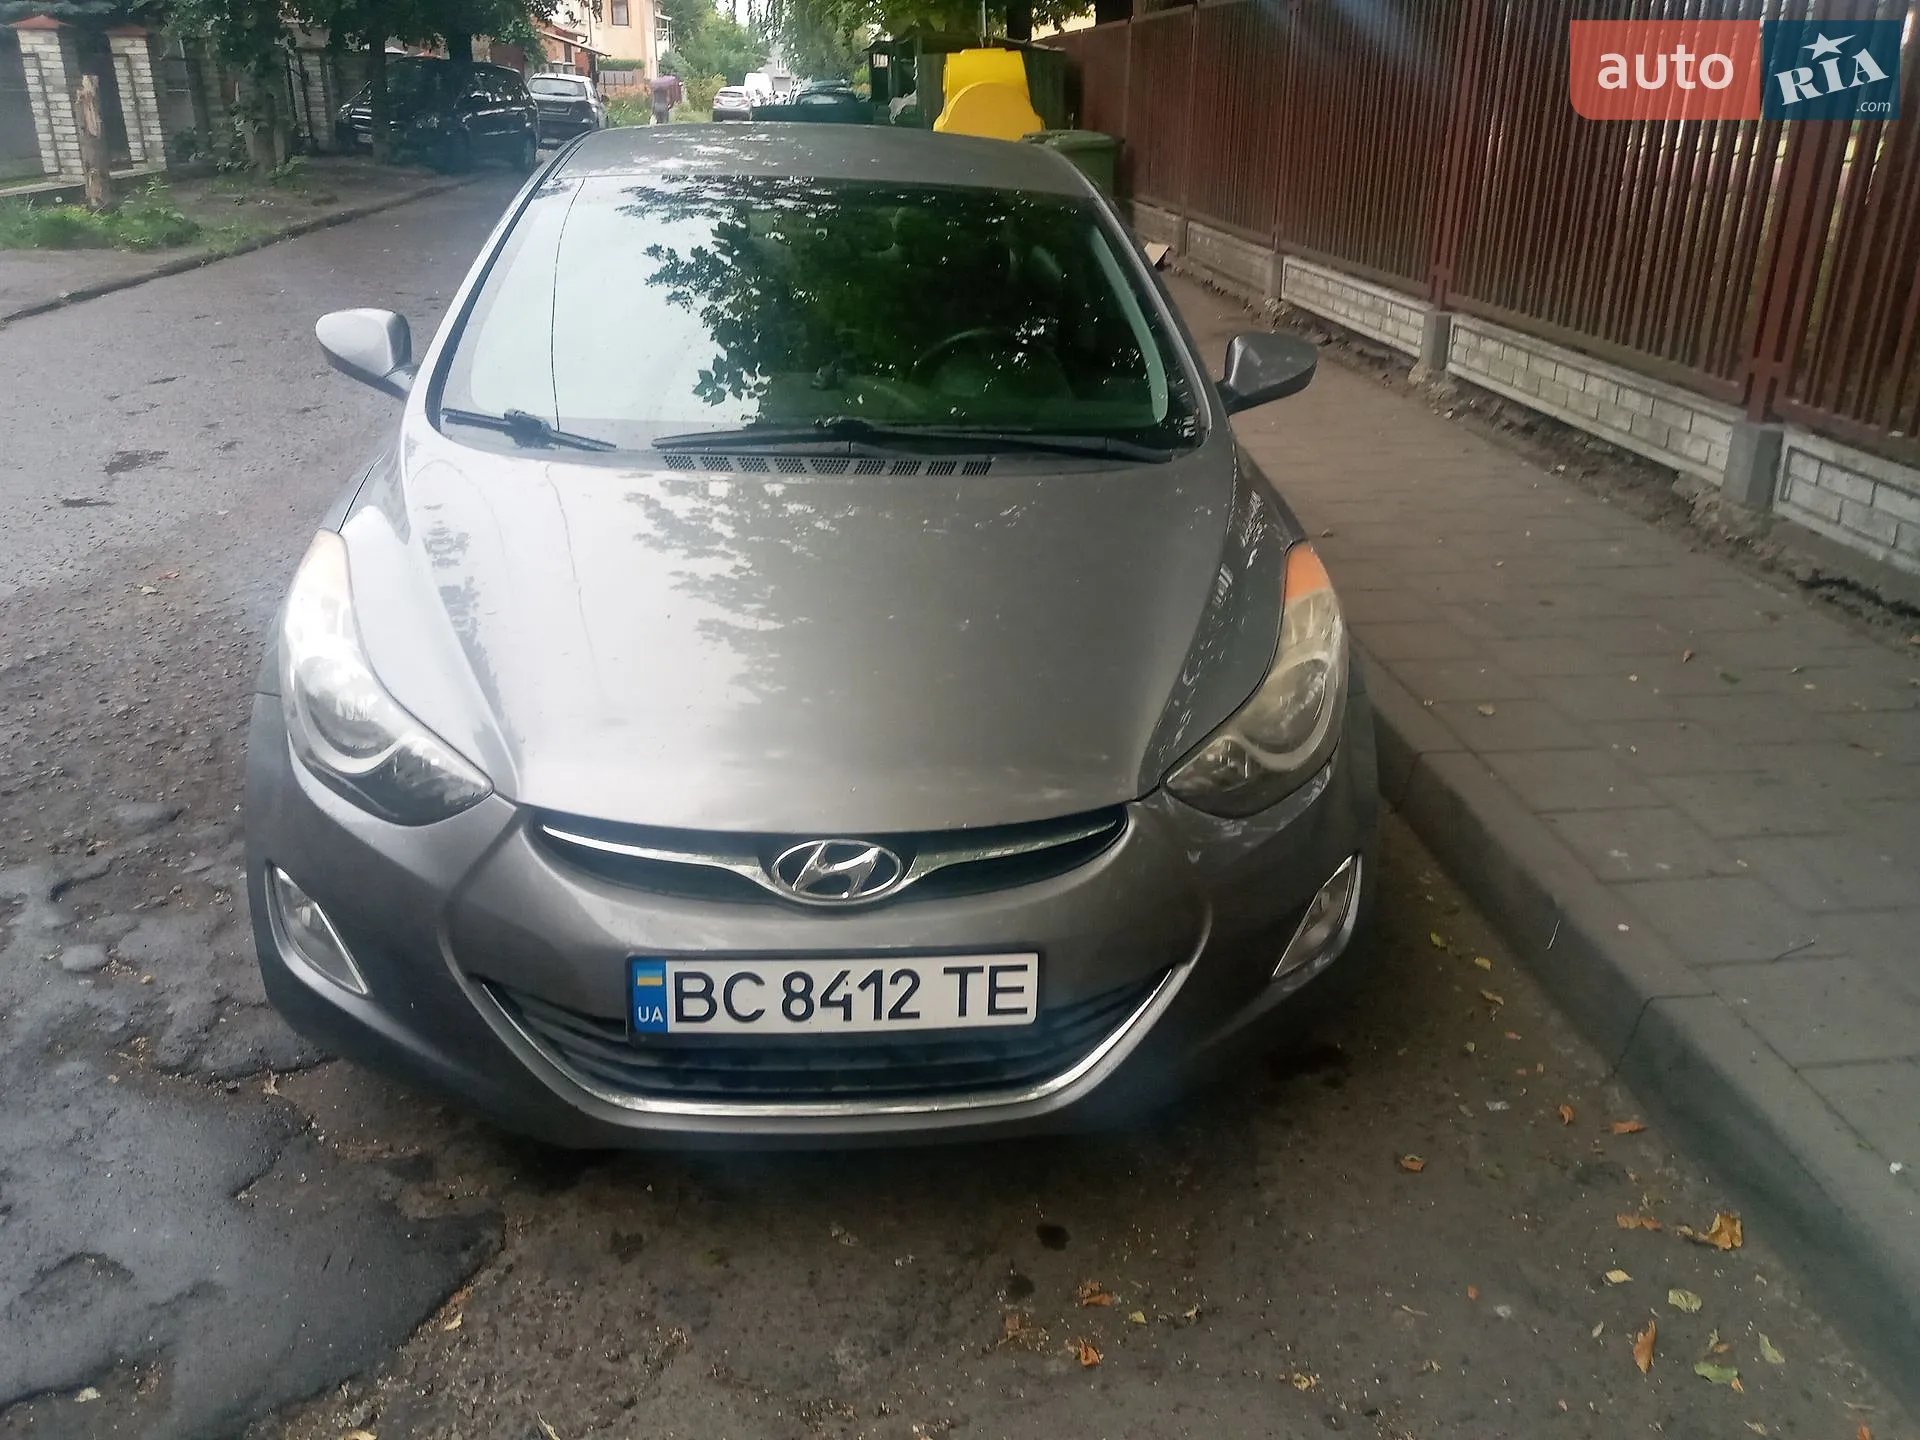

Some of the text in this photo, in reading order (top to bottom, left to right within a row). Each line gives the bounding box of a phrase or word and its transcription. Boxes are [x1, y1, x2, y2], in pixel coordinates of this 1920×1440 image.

[674, 963, 1029, 1023] BC 8412 TE
[638, 1006, 664, 1023] UA
